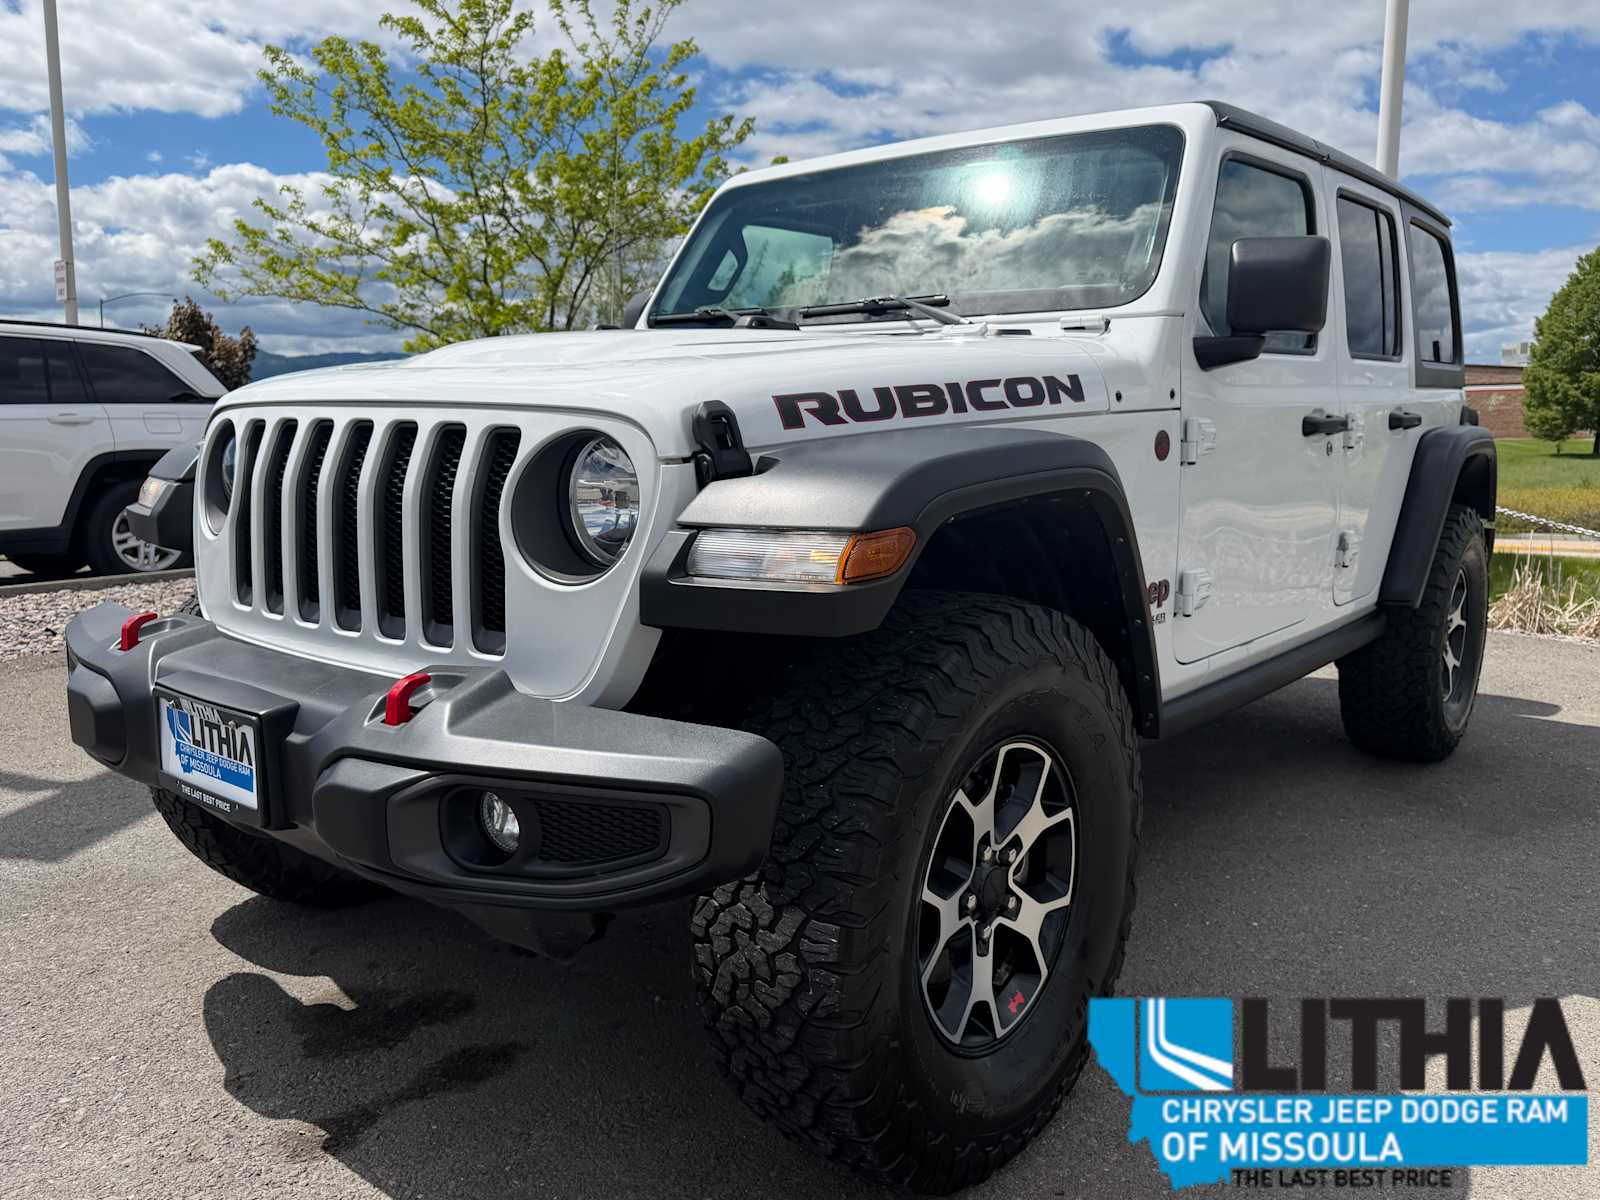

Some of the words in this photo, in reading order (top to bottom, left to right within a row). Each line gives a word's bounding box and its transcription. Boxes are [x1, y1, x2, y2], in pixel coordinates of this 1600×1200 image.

[772, 374, 1086, 430] RUBICON
[191, 717, 254, 767] LITHIA
[180, 743, 206, 761] CHRYSLER
[205, 752, 218, 765] JEEP
[220, 757, 238, 773] DODGE
[238, 764, 251, 777] RAM
[180, 753, 190, 766] OF
[190, 757, 222, 779] MISSOULA
[181, 783, 191, 796] THE
[190, 787, 203, 800] LAST
[202, 793, 216, 806] BEST
[215, 798, 231, 813] PRICE
